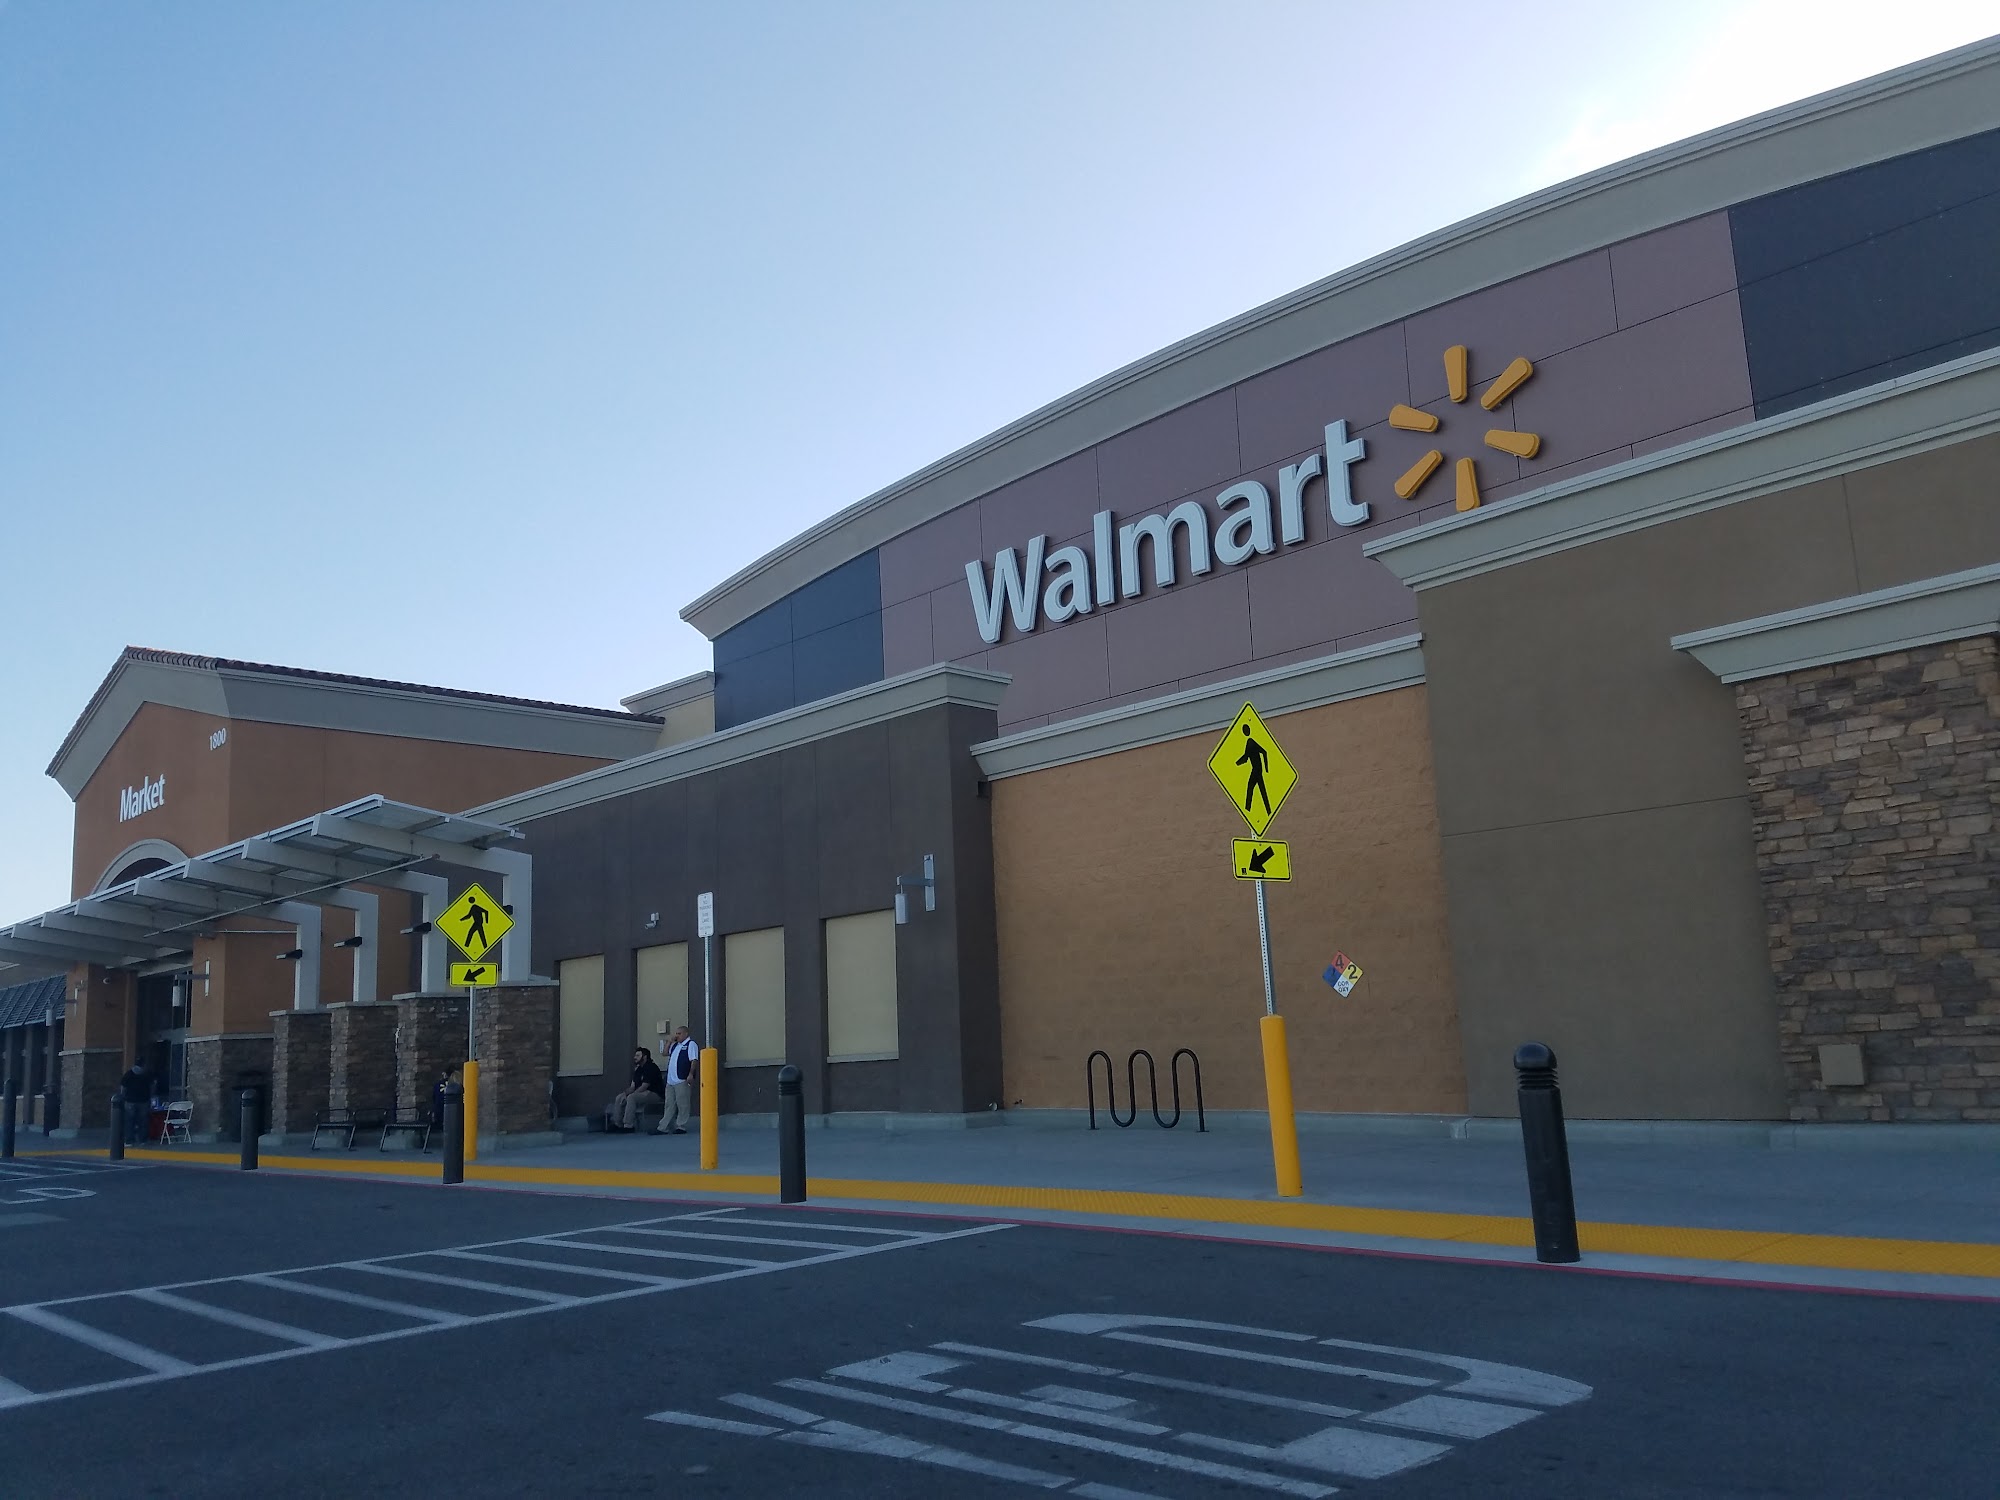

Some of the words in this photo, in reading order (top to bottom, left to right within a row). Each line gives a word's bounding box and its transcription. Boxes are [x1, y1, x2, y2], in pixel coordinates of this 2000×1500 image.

[964, 418, 1370, 644] Walmart
[209, 727, 227, 751] 1800
[119, 773, 166, 823] Market
[1335, 954, 1344, 968] 4
[1347, 964, 1358, 980] 2
